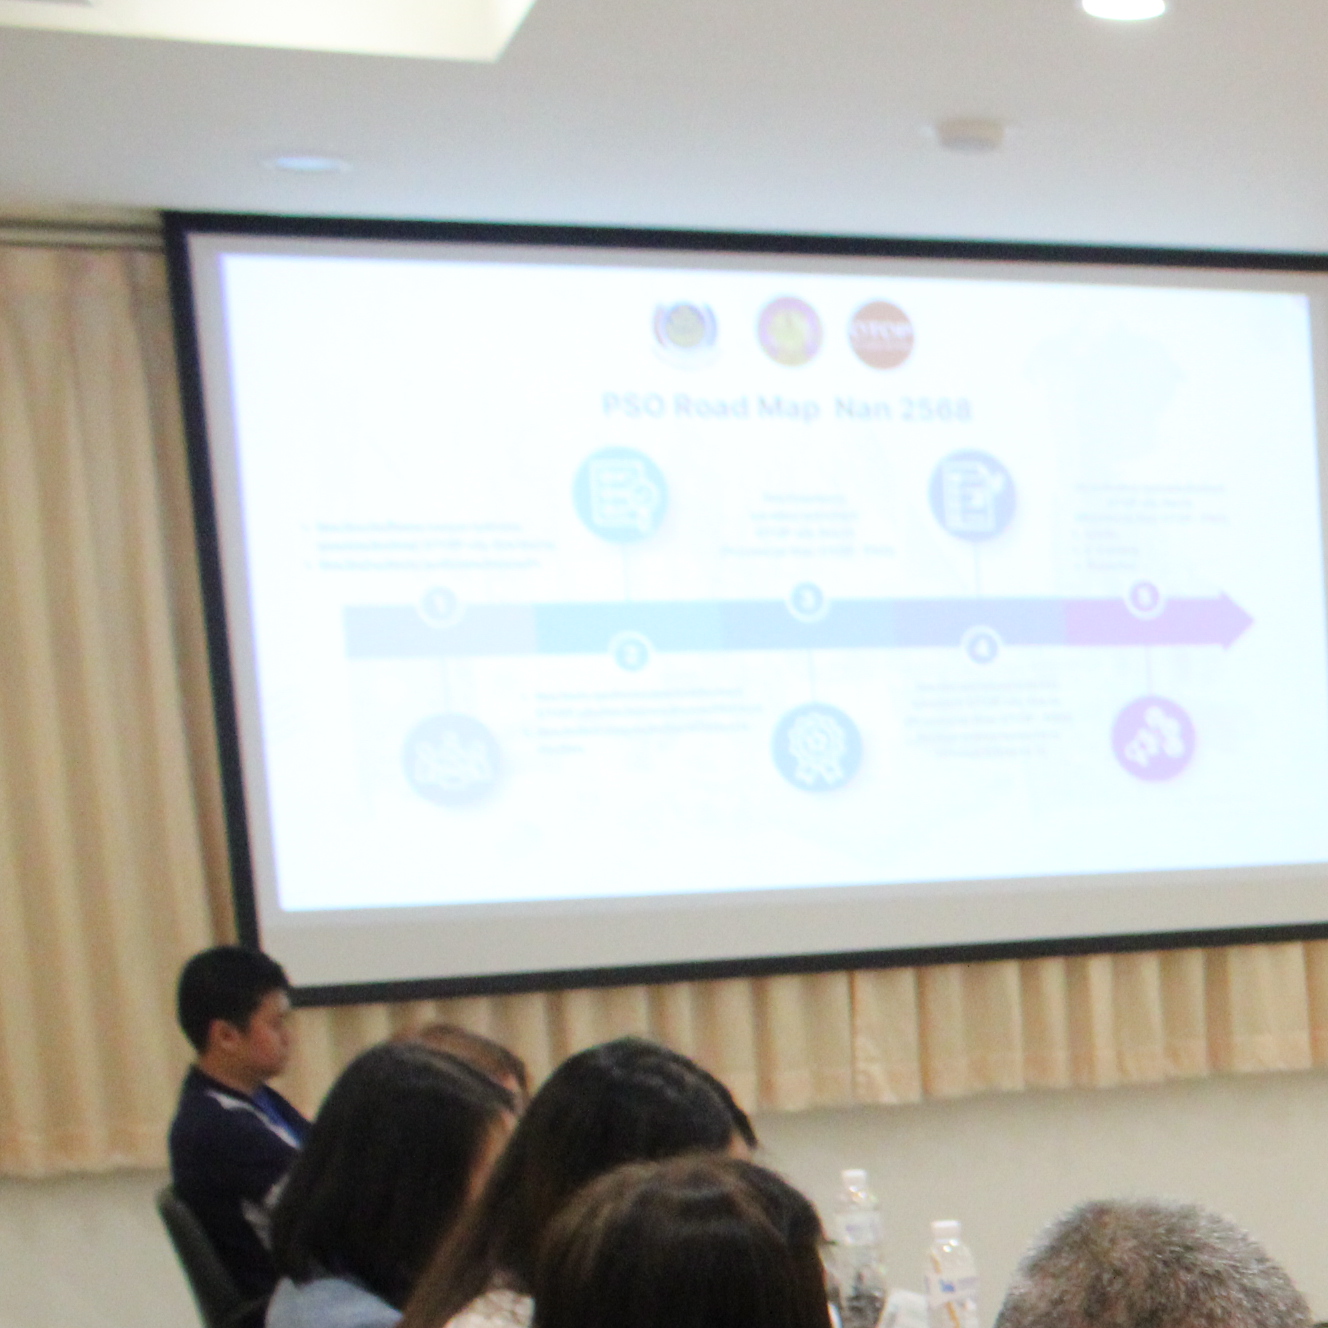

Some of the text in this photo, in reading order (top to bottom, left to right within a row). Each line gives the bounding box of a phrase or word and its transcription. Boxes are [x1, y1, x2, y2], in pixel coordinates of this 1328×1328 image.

[601, 392, 972, 425] PSO Road Map Nan 2568
